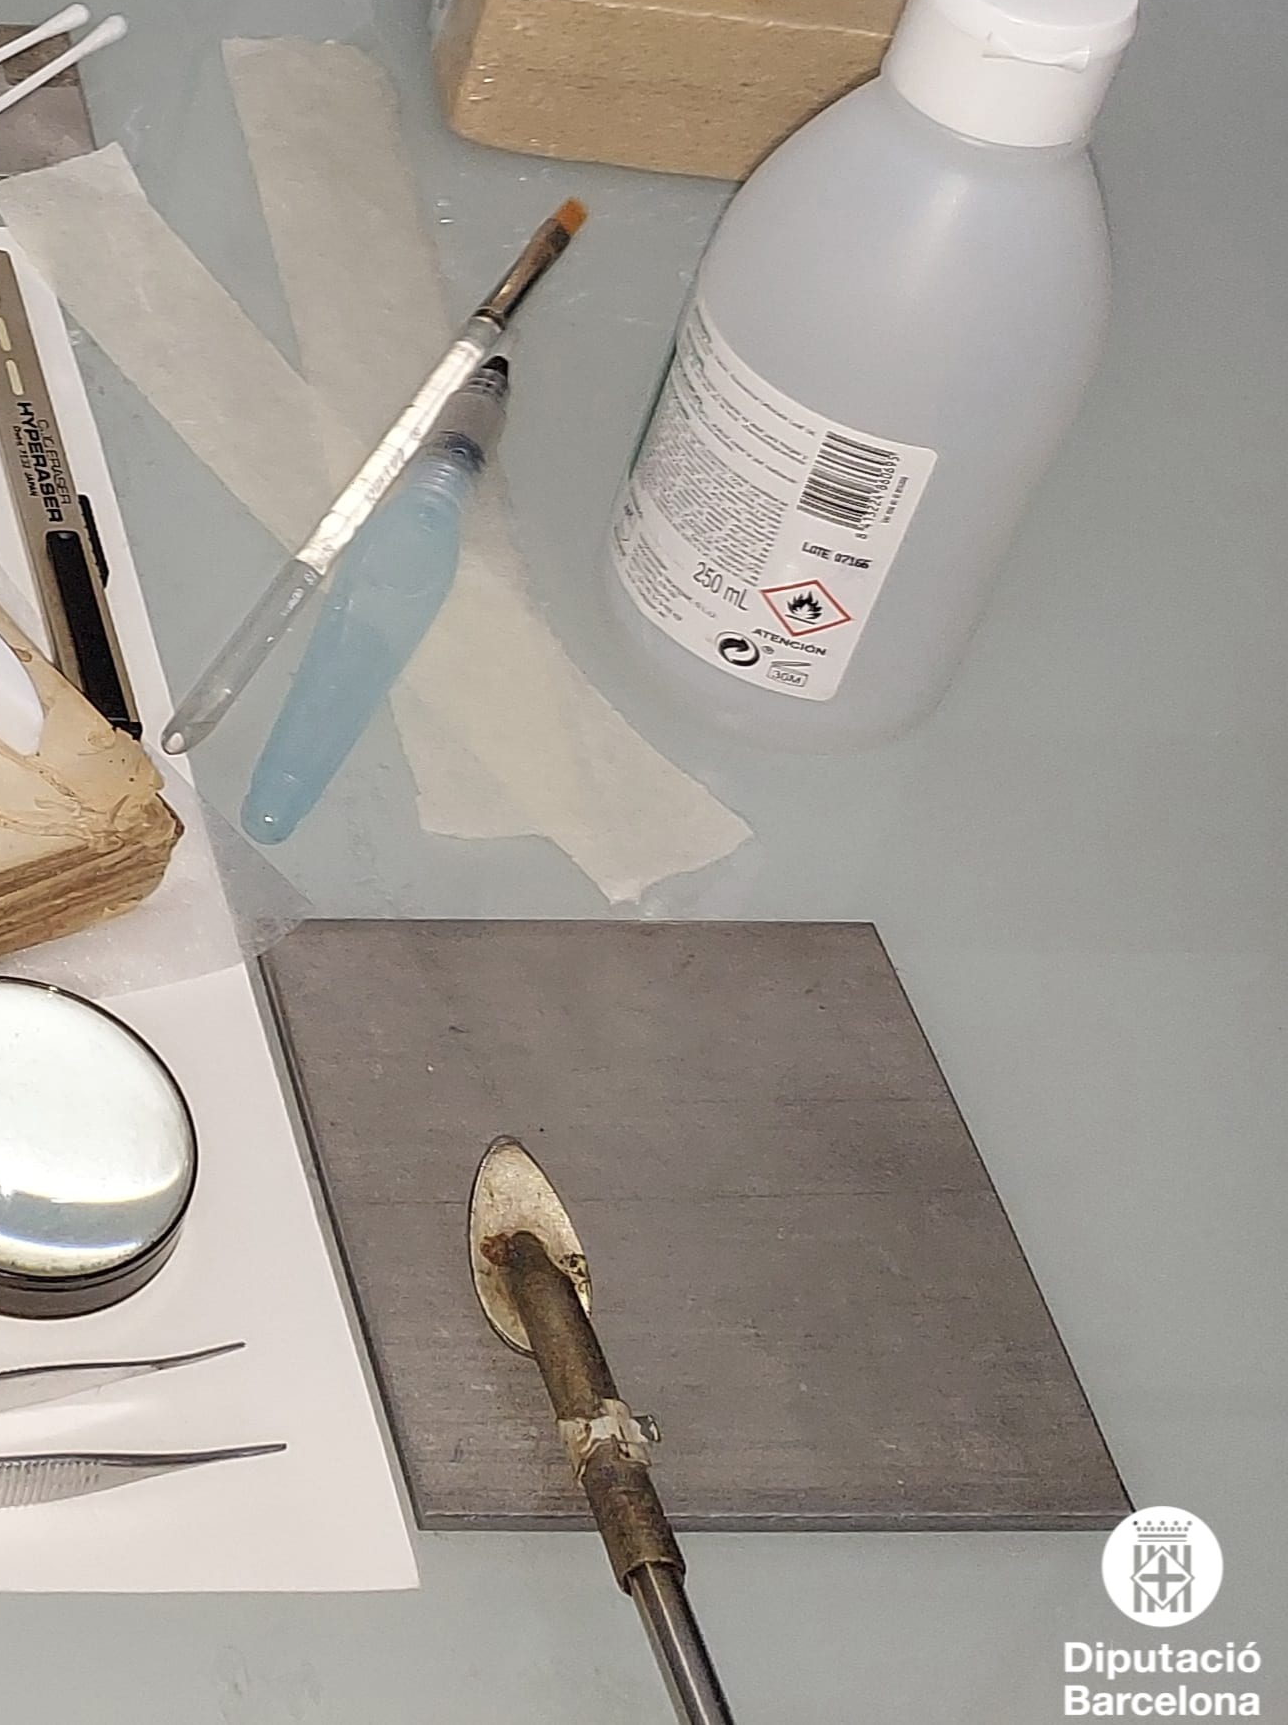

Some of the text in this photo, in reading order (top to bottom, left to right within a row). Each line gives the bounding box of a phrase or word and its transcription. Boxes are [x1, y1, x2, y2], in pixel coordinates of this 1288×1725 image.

[16, 402, 64, 523] HYPERASER
[692, 561, 723, 596] 250
[752, 627, 828, 658] ATENCIÓN
